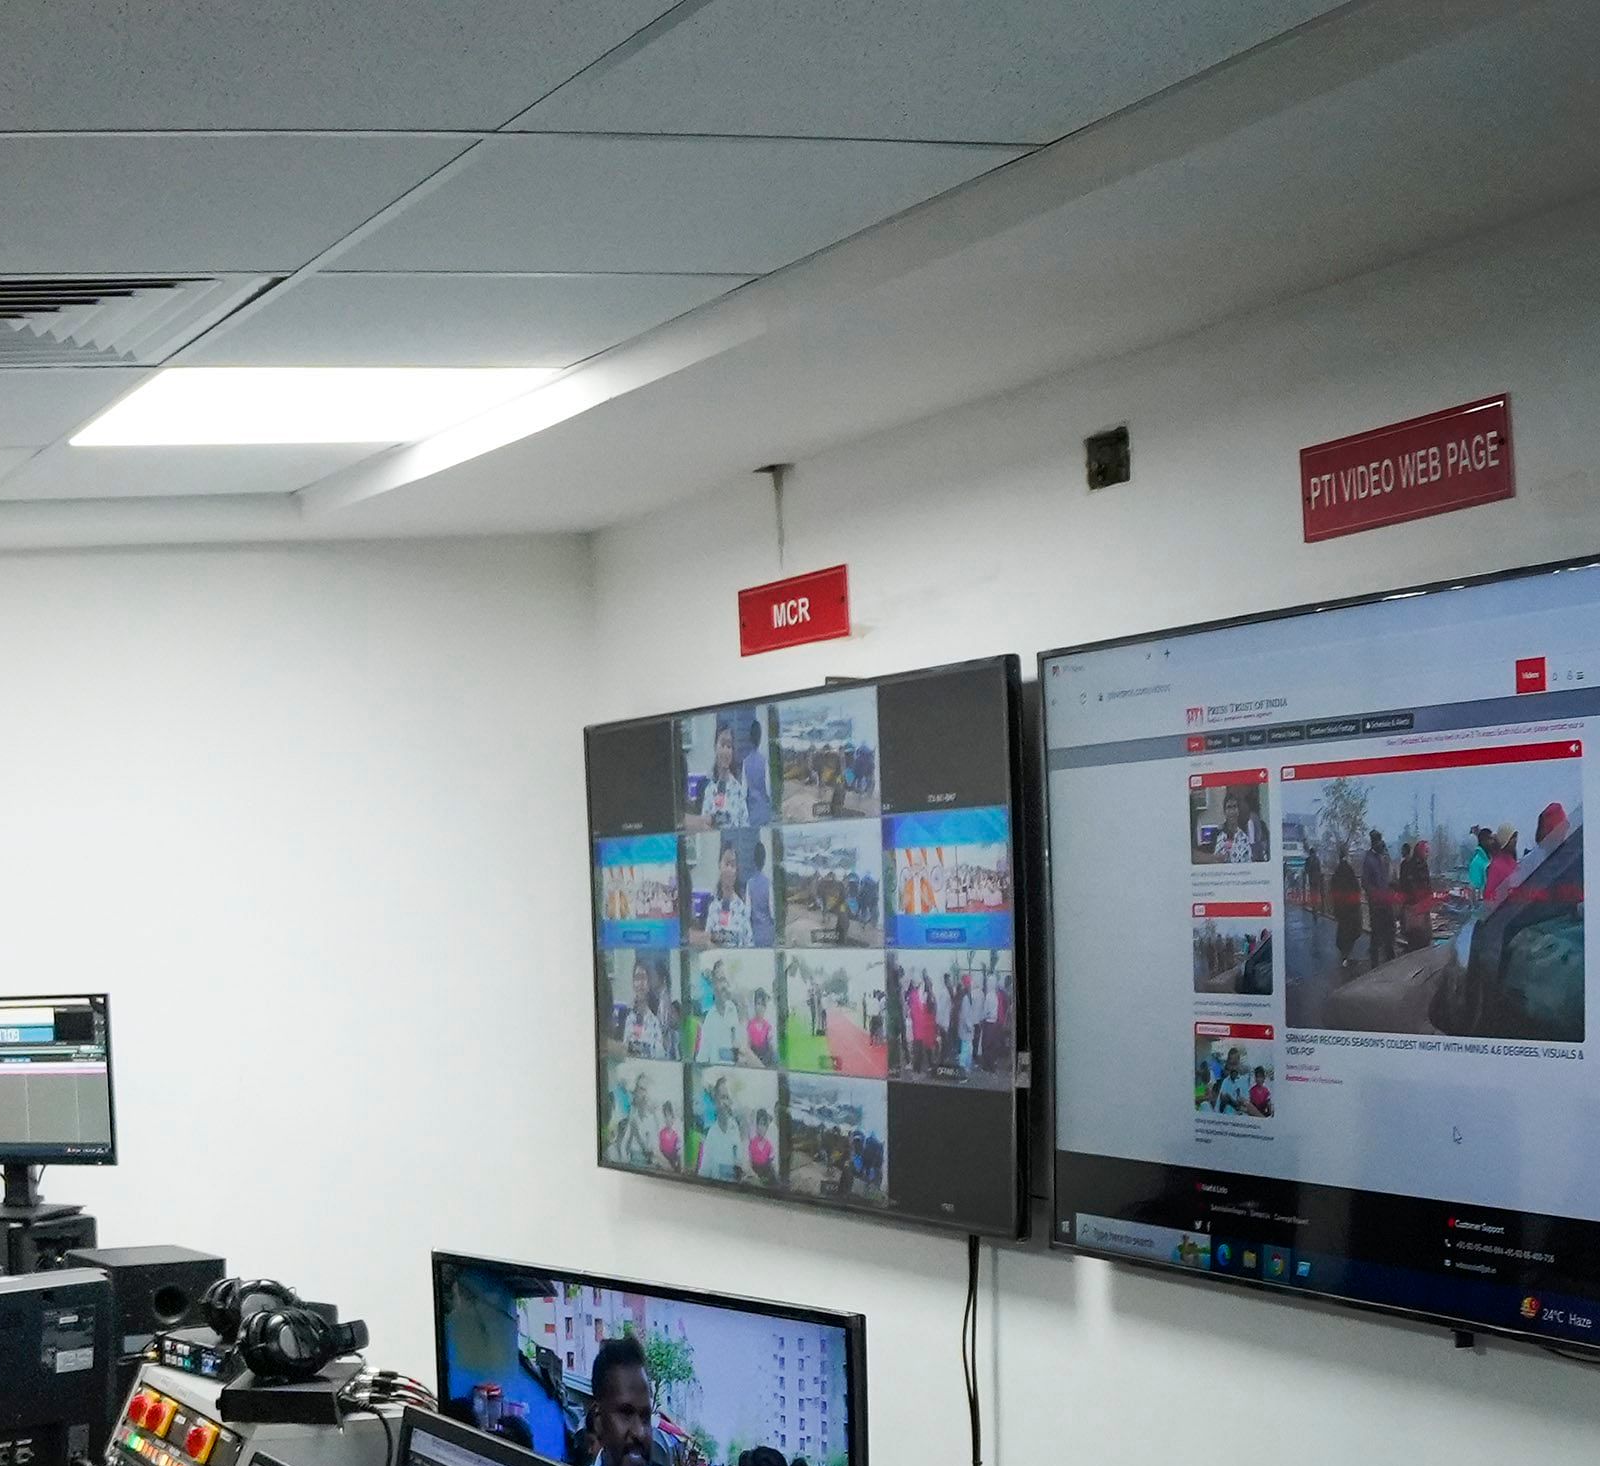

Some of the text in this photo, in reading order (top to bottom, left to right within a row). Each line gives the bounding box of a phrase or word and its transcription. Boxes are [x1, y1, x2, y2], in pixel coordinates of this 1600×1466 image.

[1310, 431, 1499, 510] PTI VIDEO WEB PAGE
[773, 597, 810, 628] MCR
[1263, 698, 1288, 708] INDIA
[1320, 1035, 1350, 1047] RECORDS
[1386, 1039, 1417, 1050] COLDEST
[1419, 1041, 1440, 1051] NIGHT
[1443, 1043, 1462, 1052] WITH
[1465, 1044, 1488, 1054] MINUS
[1542, 1049, 1576, 1060] VISUALS
[1542, 1308, 1592, 1328] 24°C Haze
